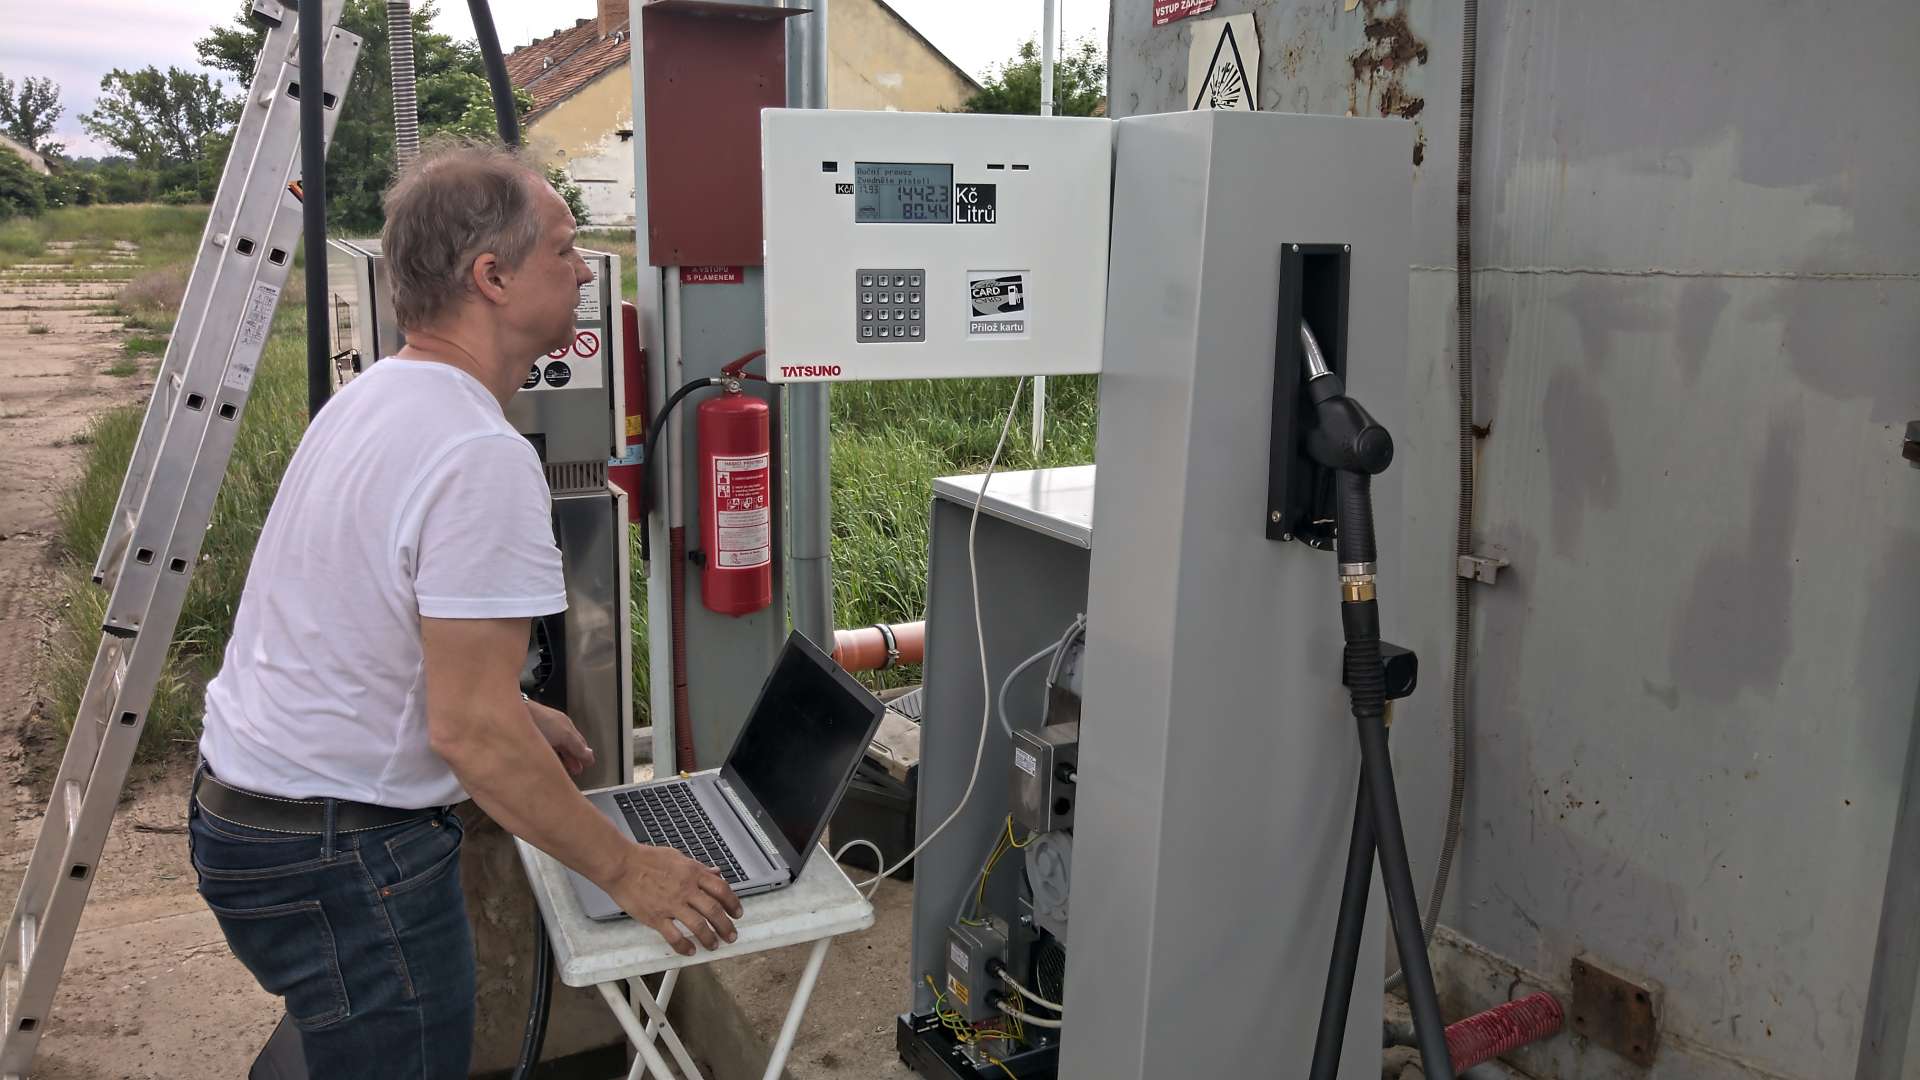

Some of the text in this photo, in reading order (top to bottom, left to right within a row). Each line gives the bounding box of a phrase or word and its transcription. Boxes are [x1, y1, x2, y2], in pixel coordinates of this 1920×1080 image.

[1155, 2, 1180, 17] VSTUP
[897, 185, 949, 203] 1442.3
[956, 186, 978, 204] Kč
[902, 203, 949, 220] 80.44
[956, 204, 995, 222] Litrů
[972, 286, 1001, 298] CARD
[971, 322, 1023, 332] Přilož kartu
[780, 365, 842, 378] TATSUNO
